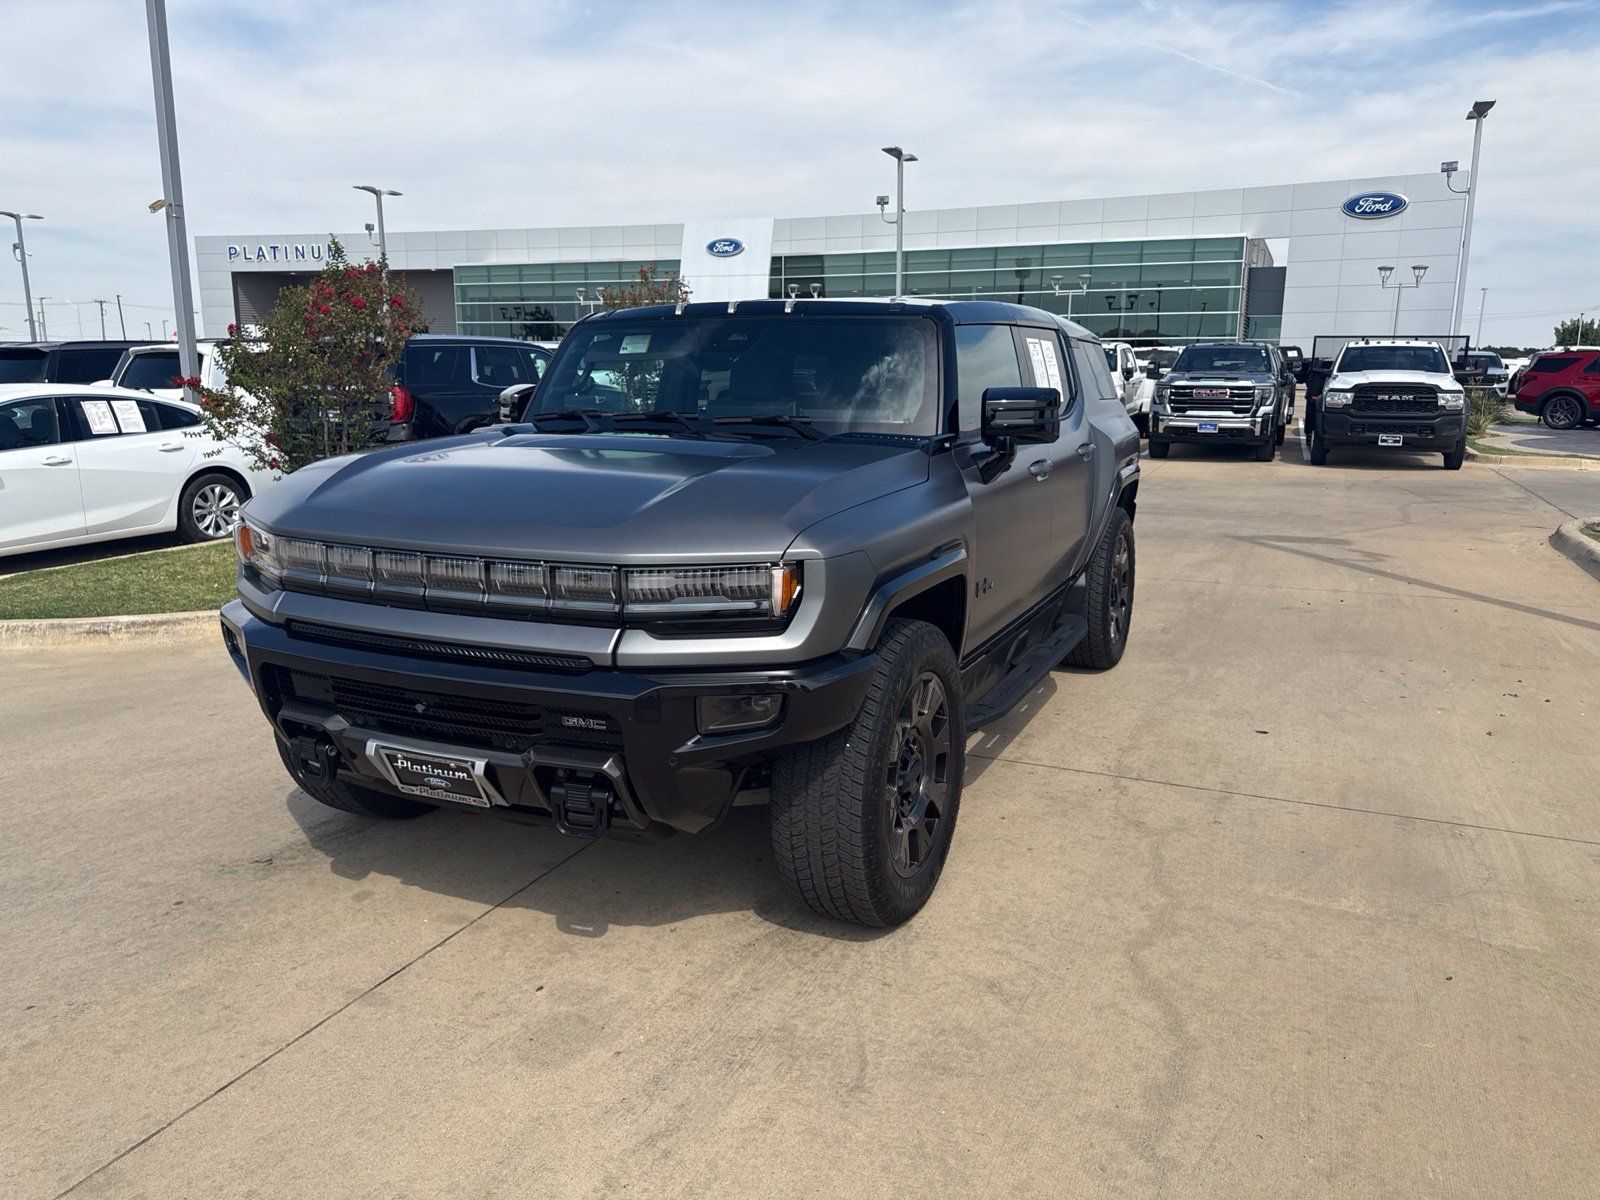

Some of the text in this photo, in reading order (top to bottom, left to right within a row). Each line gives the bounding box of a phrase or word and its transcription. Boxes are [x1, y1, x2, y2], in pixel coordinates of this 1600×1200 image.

[1354, 197, 1394, 213] Ford
[713, 241, 735, 252] Ford
[562, 716, 607, 730] GMC
[393, 758, 473, 781] Platinum
[419, 787, 468, 803] Platinum
